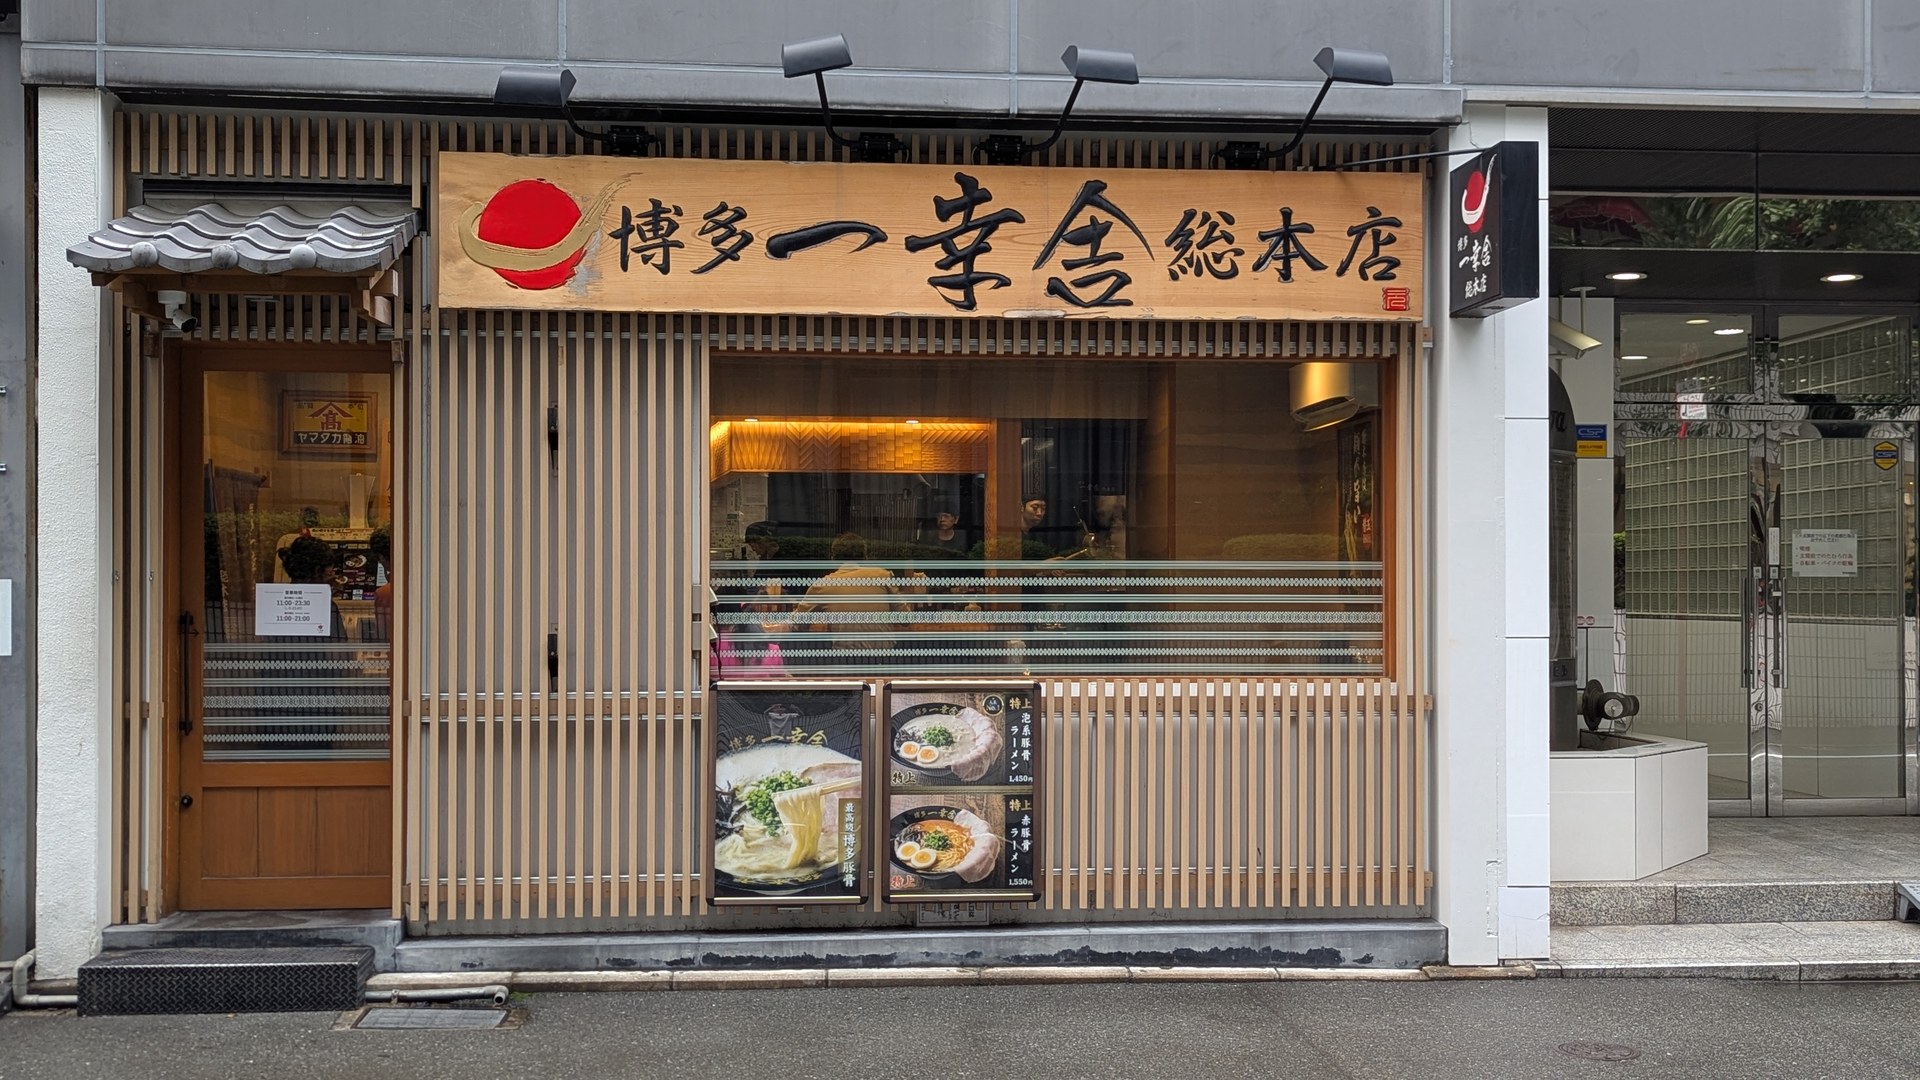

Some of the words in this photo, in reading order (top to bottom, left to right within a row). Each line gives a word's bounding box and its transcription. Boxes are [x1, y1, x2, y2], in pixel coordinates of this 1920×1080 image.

[1578, 428, 1604, 436] CSP
[1009, 697, 1033, 710] 特上
[1021, 712, 1032, 761] 泡系豚骨
[1010, 725, 1020, 771] ラーメン
[892, 771, 916, 784] 特上
[1009, 799, 1033, 812] 特上
[1021, 814, 1032, 851] 赤豚骨
[1010, 828, 1020, 873] ラーメン
[1009, 878, 1033, 886] 1,550円
